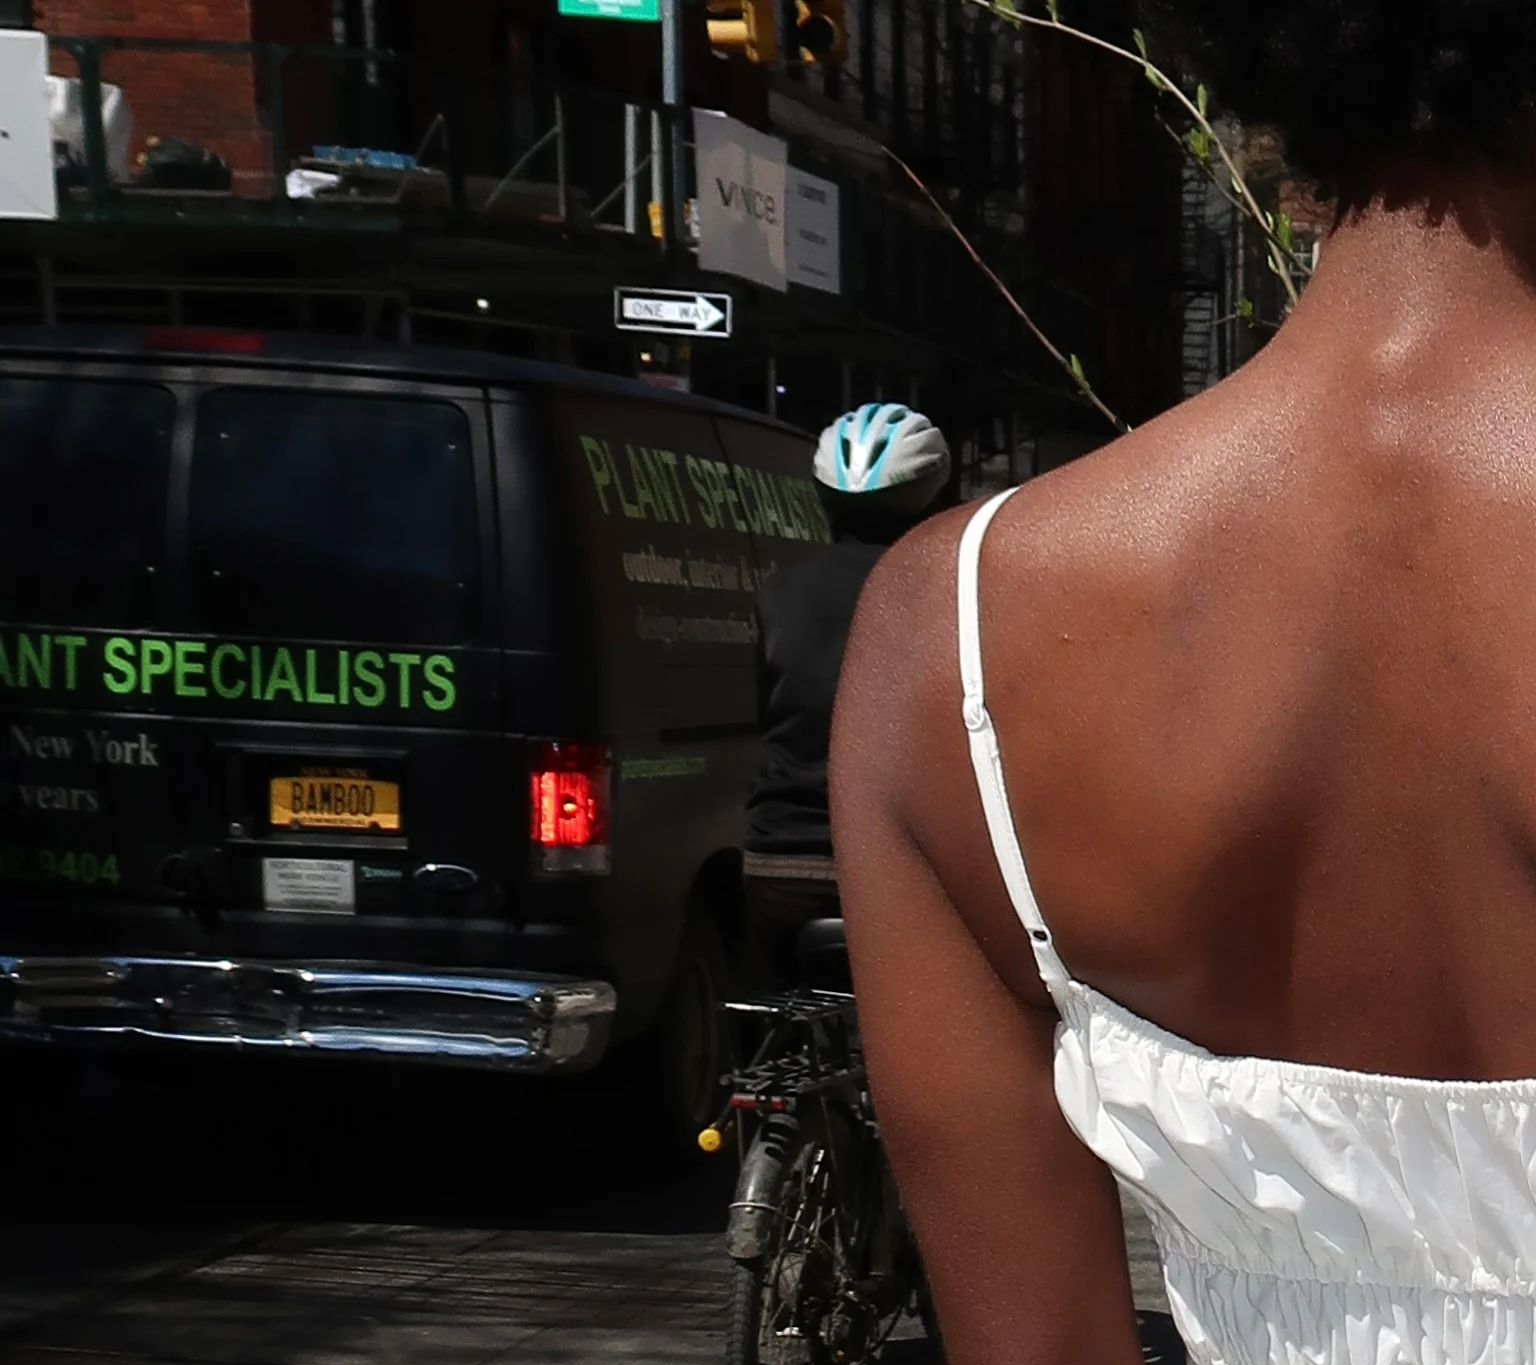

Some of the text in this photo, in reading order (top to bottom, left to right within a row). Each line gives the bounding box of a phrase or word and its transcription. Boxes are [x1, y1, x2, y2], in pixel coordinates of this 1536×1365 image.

[633, 300, 712, 321] ONE WAY
[580, 434, 833, 545] PLANT SPECIALISTS
[103, 636, 457, 711] SPECIALISTS
[9, 722, 159, 767] New York
[17, 783, 100, 817] years
[291, 781, 376, 816] BAMBOO
[37, 846, 123, 887] 9404
